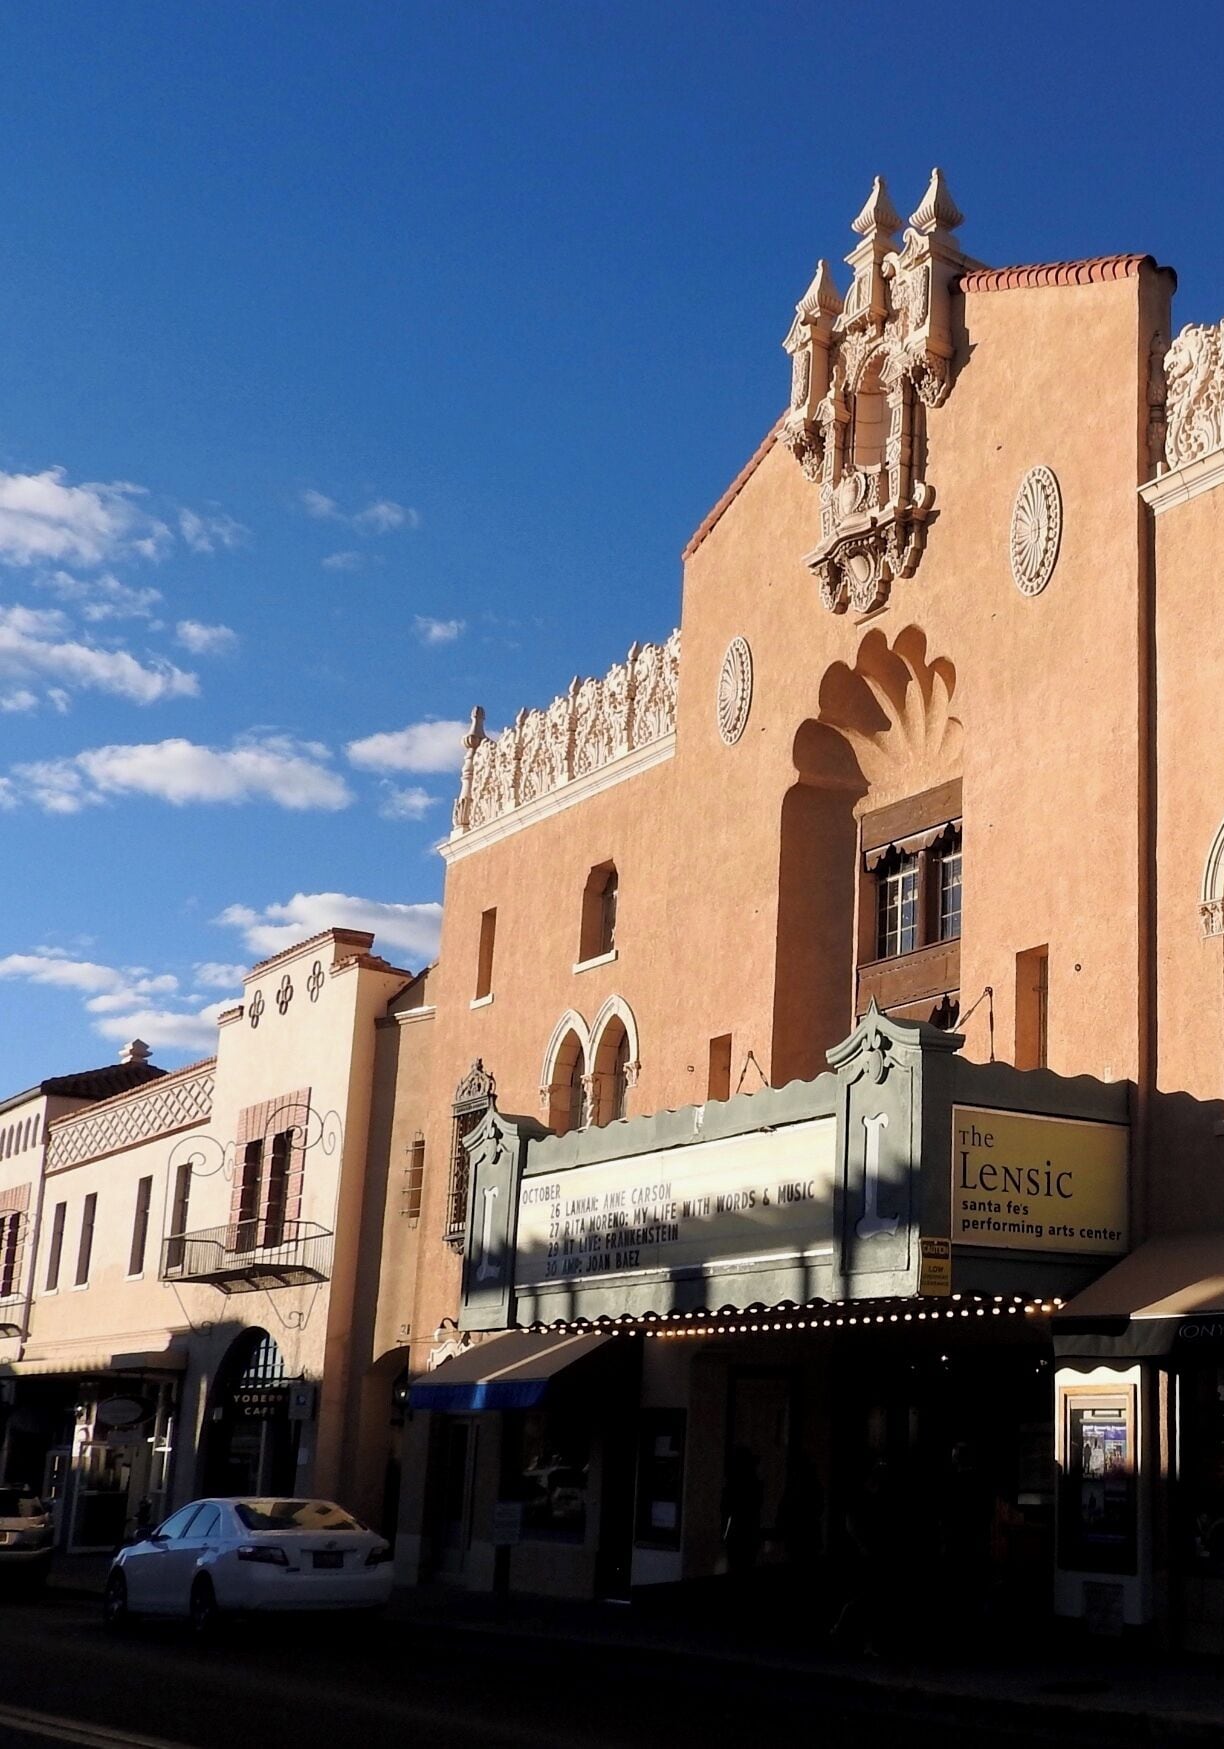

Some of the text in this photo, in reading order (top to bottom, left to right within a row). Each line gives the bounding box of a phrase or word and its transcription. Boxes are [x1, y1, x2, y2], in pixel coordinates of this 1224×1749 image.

[522, 1183, 561, 1205] OCTOBER
[550, 1183, 672, 1219] 26 LANNAN: ANNE CARSON
[962, 1198, 1030, 1216] santa fe's
[549, 1180, 815, 1239] 27 RITA MORENO: MY LIFE WITH WORDS & MUSIC
[547, 1242, 559, 1258] 29
[579, 1233, 602, 1254] LIVE:
[605, 1223, 679, 1250] FRANKENSTEIN
[962, 1217, 1122, 1242] performing arts center
[545, 1261, 557, 1278] 30
[585, 1255, 611, 1273] JOAN
[616, 1250, 640, 1268] BAEZ
[233, 1394, 289, 1404] YOBERR
